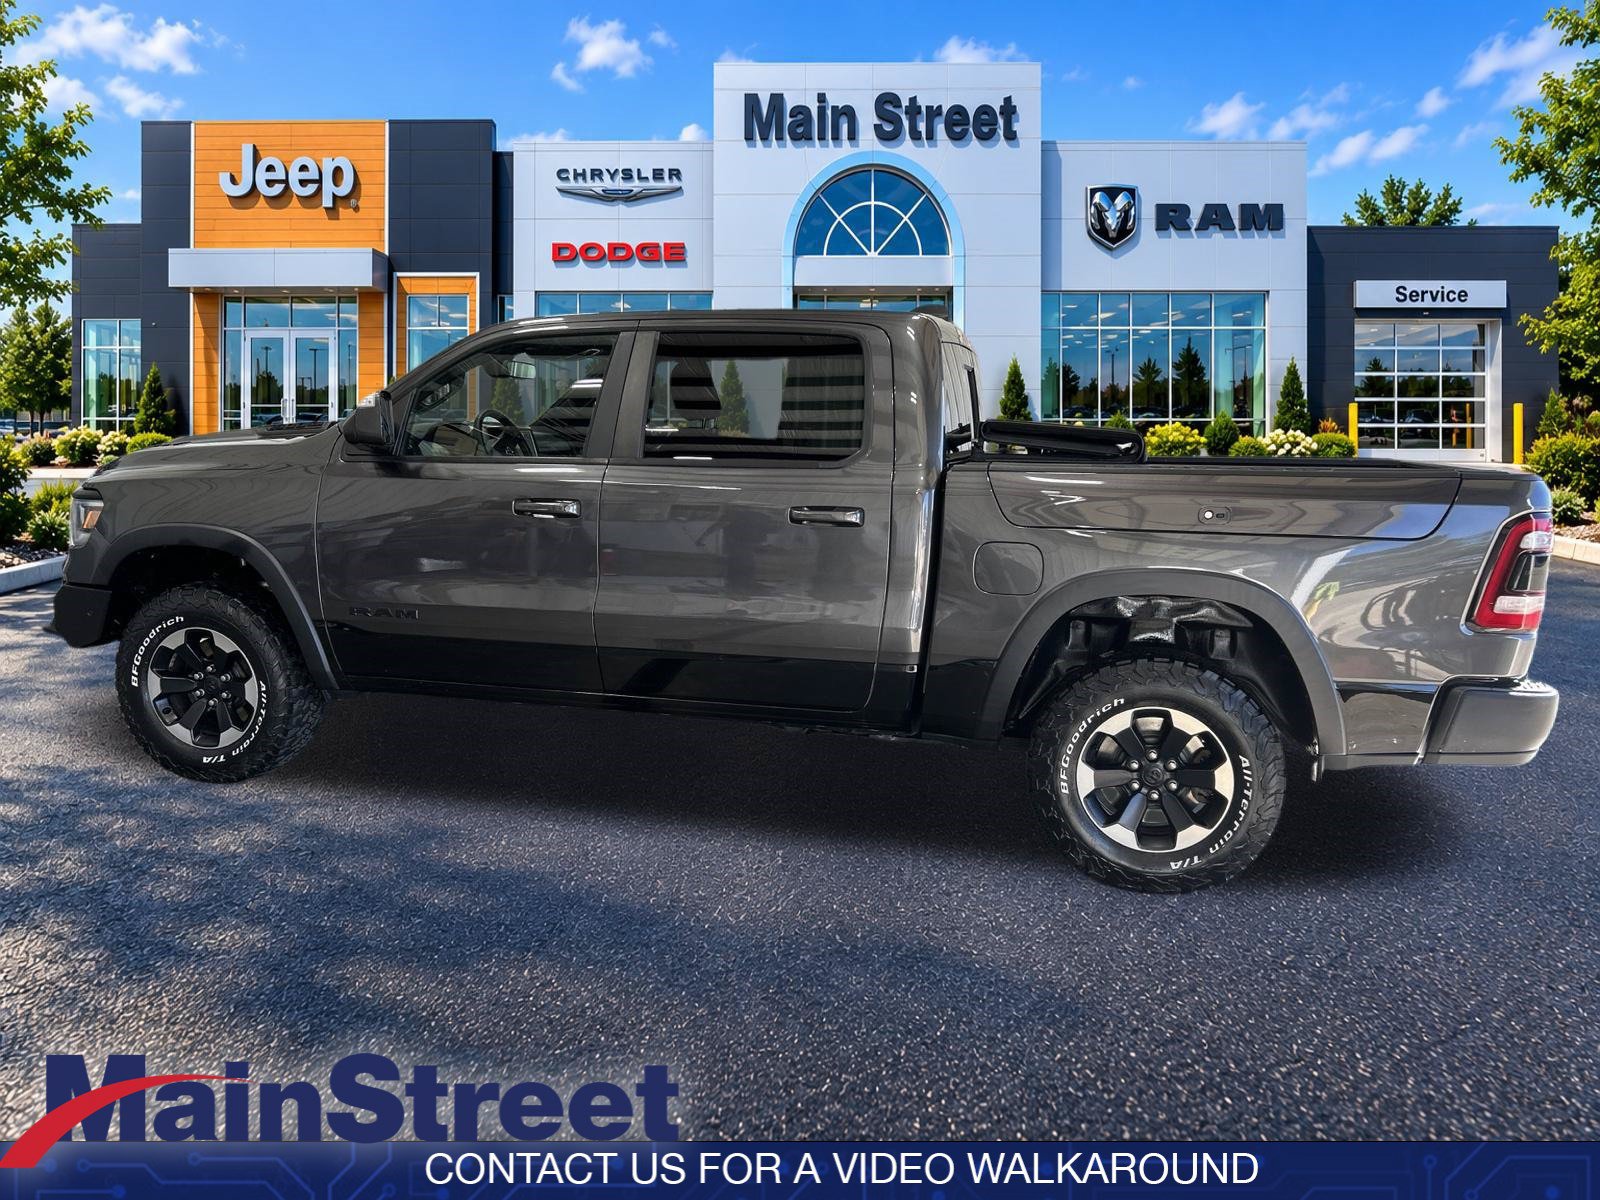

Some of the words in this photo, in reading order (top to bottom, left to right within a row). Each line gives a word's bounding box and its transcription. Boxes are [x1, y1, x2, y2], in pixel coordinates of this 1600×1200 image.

[744, 92, 857, 141] Main
[873, 92, 1017, 141] Street
[218, 143, 355, 208] Jeep
[556, 168, 682, 182] CHRYSLER
[1155, 203, 1284, 231] RAM
[551, 242, 687, 262] DODGE
[1395, 285, 1469, 303] Service
[349, 606, 419, 620] RAM
[131, 615, 185, 687] BFGoodrich
[1059, 697, 1125, 795] BFGoodrich
[202, 755, 227, 764] T/A
[1169, 855, 1203, 871] T/A
